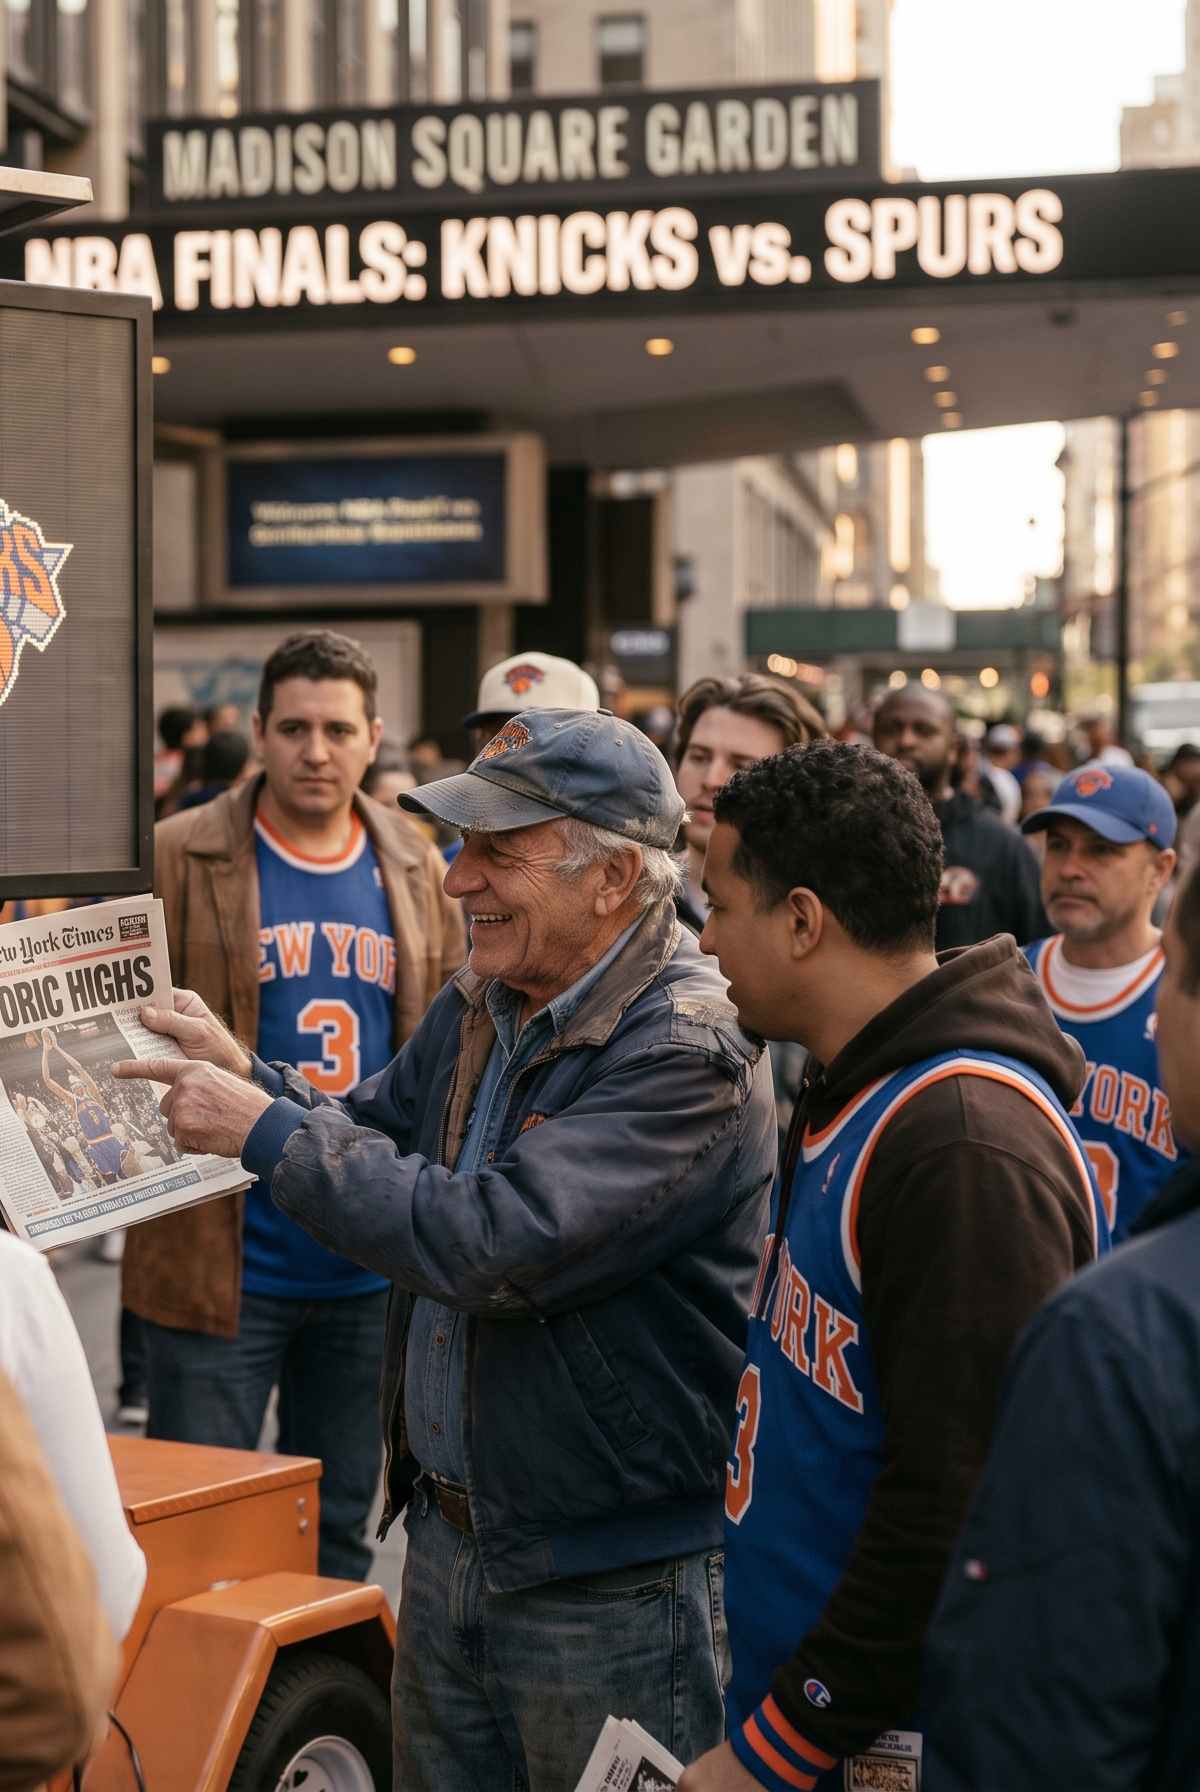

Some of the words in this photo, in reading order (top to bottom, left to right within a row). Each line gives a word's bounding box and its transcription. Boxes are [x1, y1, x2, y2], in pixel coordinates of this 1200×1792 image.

[163, 119, 397, 200] MADISON
[412, 105, 629, 193] SQUARE
[645, 92, 859, 178] GARDEN
[24, 233, 163, 311] NBA
[173, 220, 428, 311] FINALS:
[441, 207, 699, 299] KNICKS
[708, 221, 812, 287] vs.
[824, 188, 1064, 283] SPURS
[17, 931, 61, 965] York
[61, 925, 115, 950] Times
[65, 955, 155, 1013] HIGHS
[296, 998, 361, 1098] 3
[724, 1362, 762, 1526] 3
